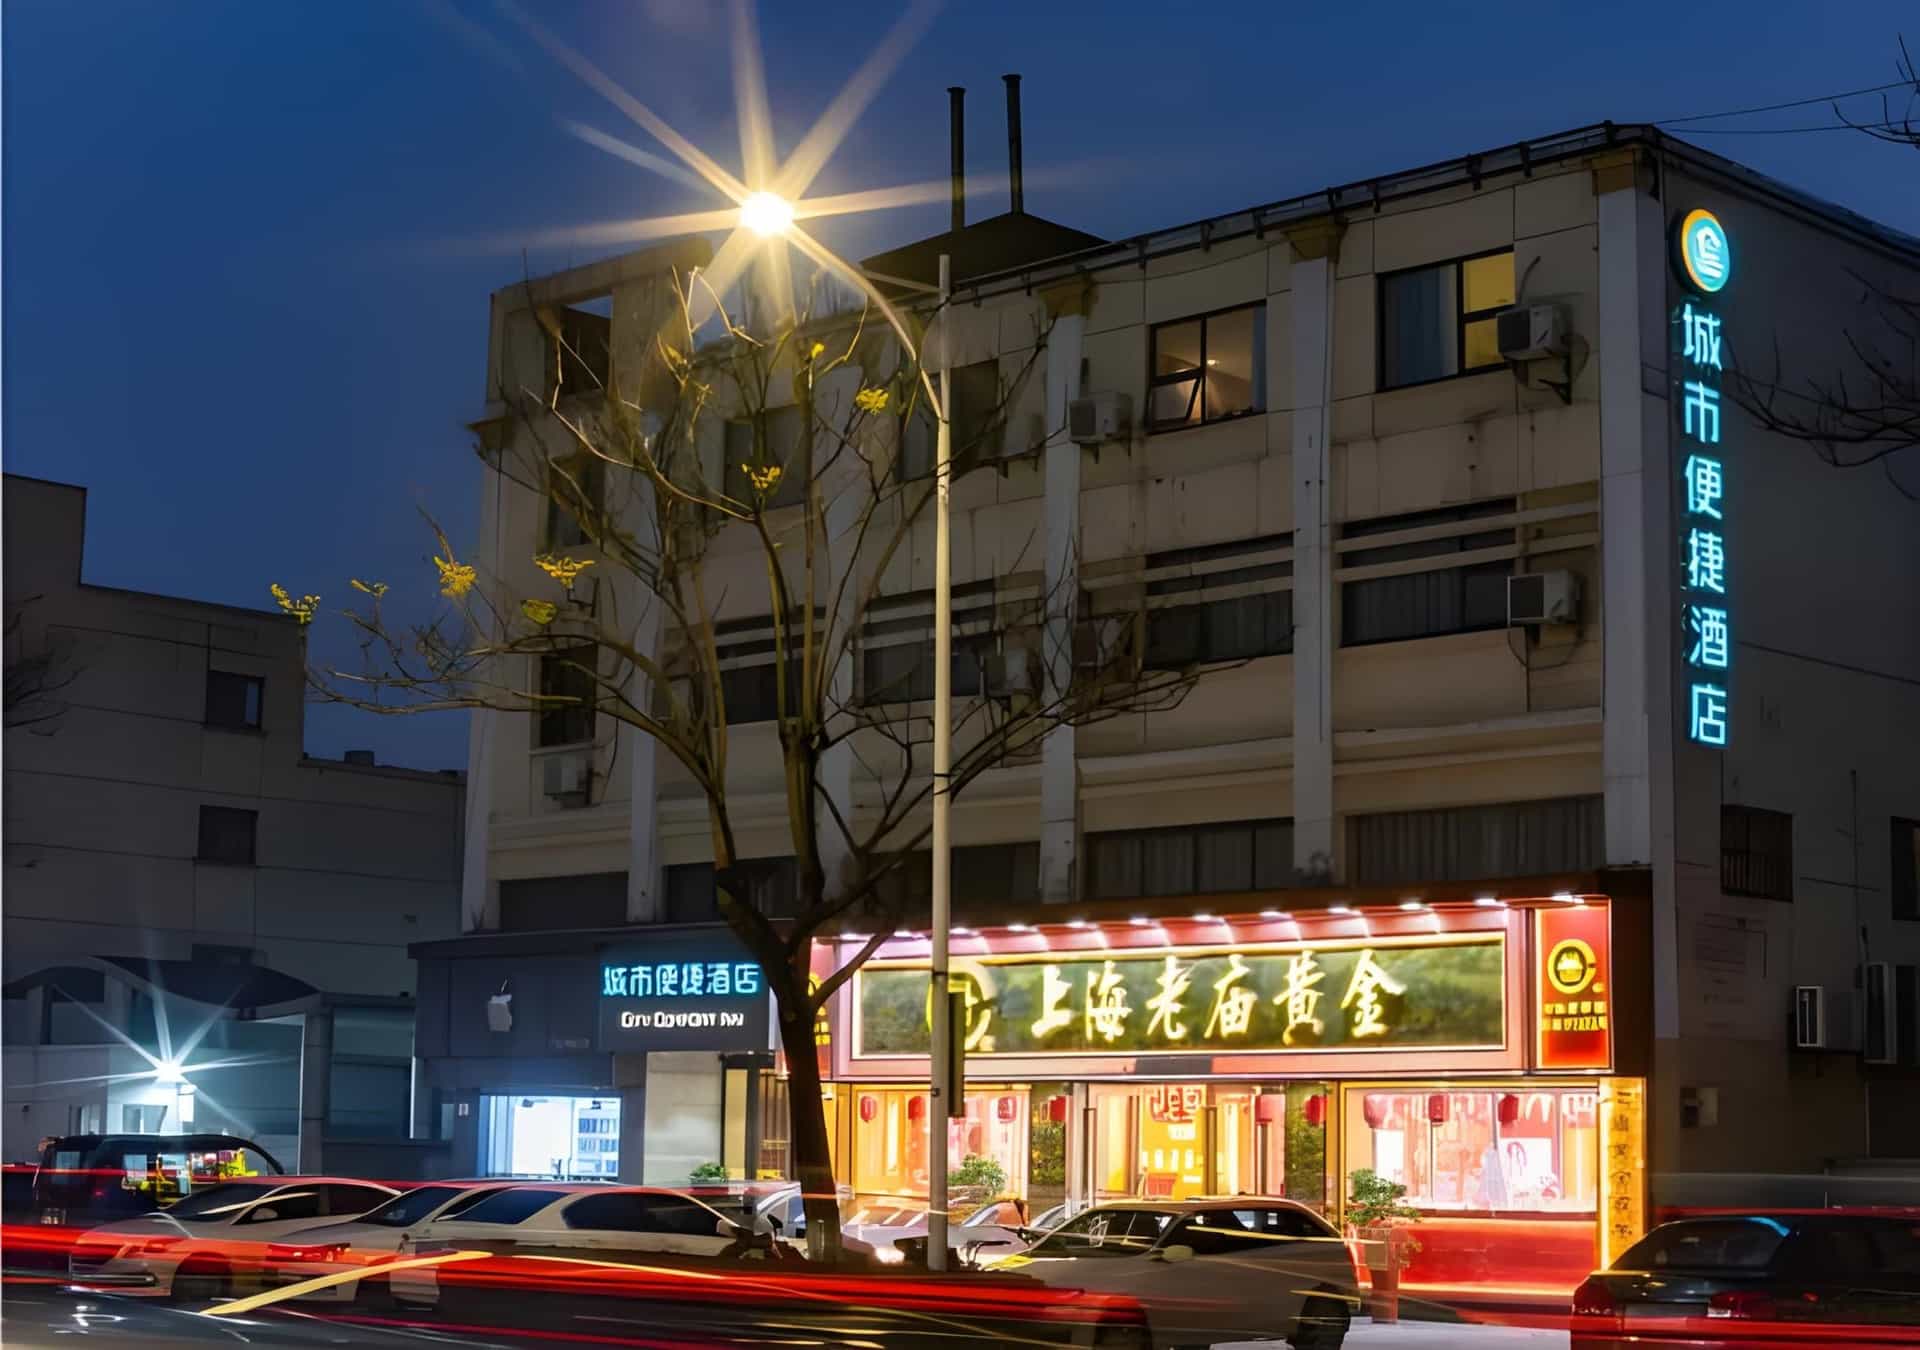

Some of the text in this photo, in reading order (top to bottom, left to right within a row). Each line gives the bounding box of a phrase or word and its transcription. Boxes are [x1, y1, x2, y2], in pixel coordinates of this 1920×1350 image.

[1682, 303, 1728, 745] 城市便捷酒店
[1031, 948, 1408, 1046] 上海老庙黄金
